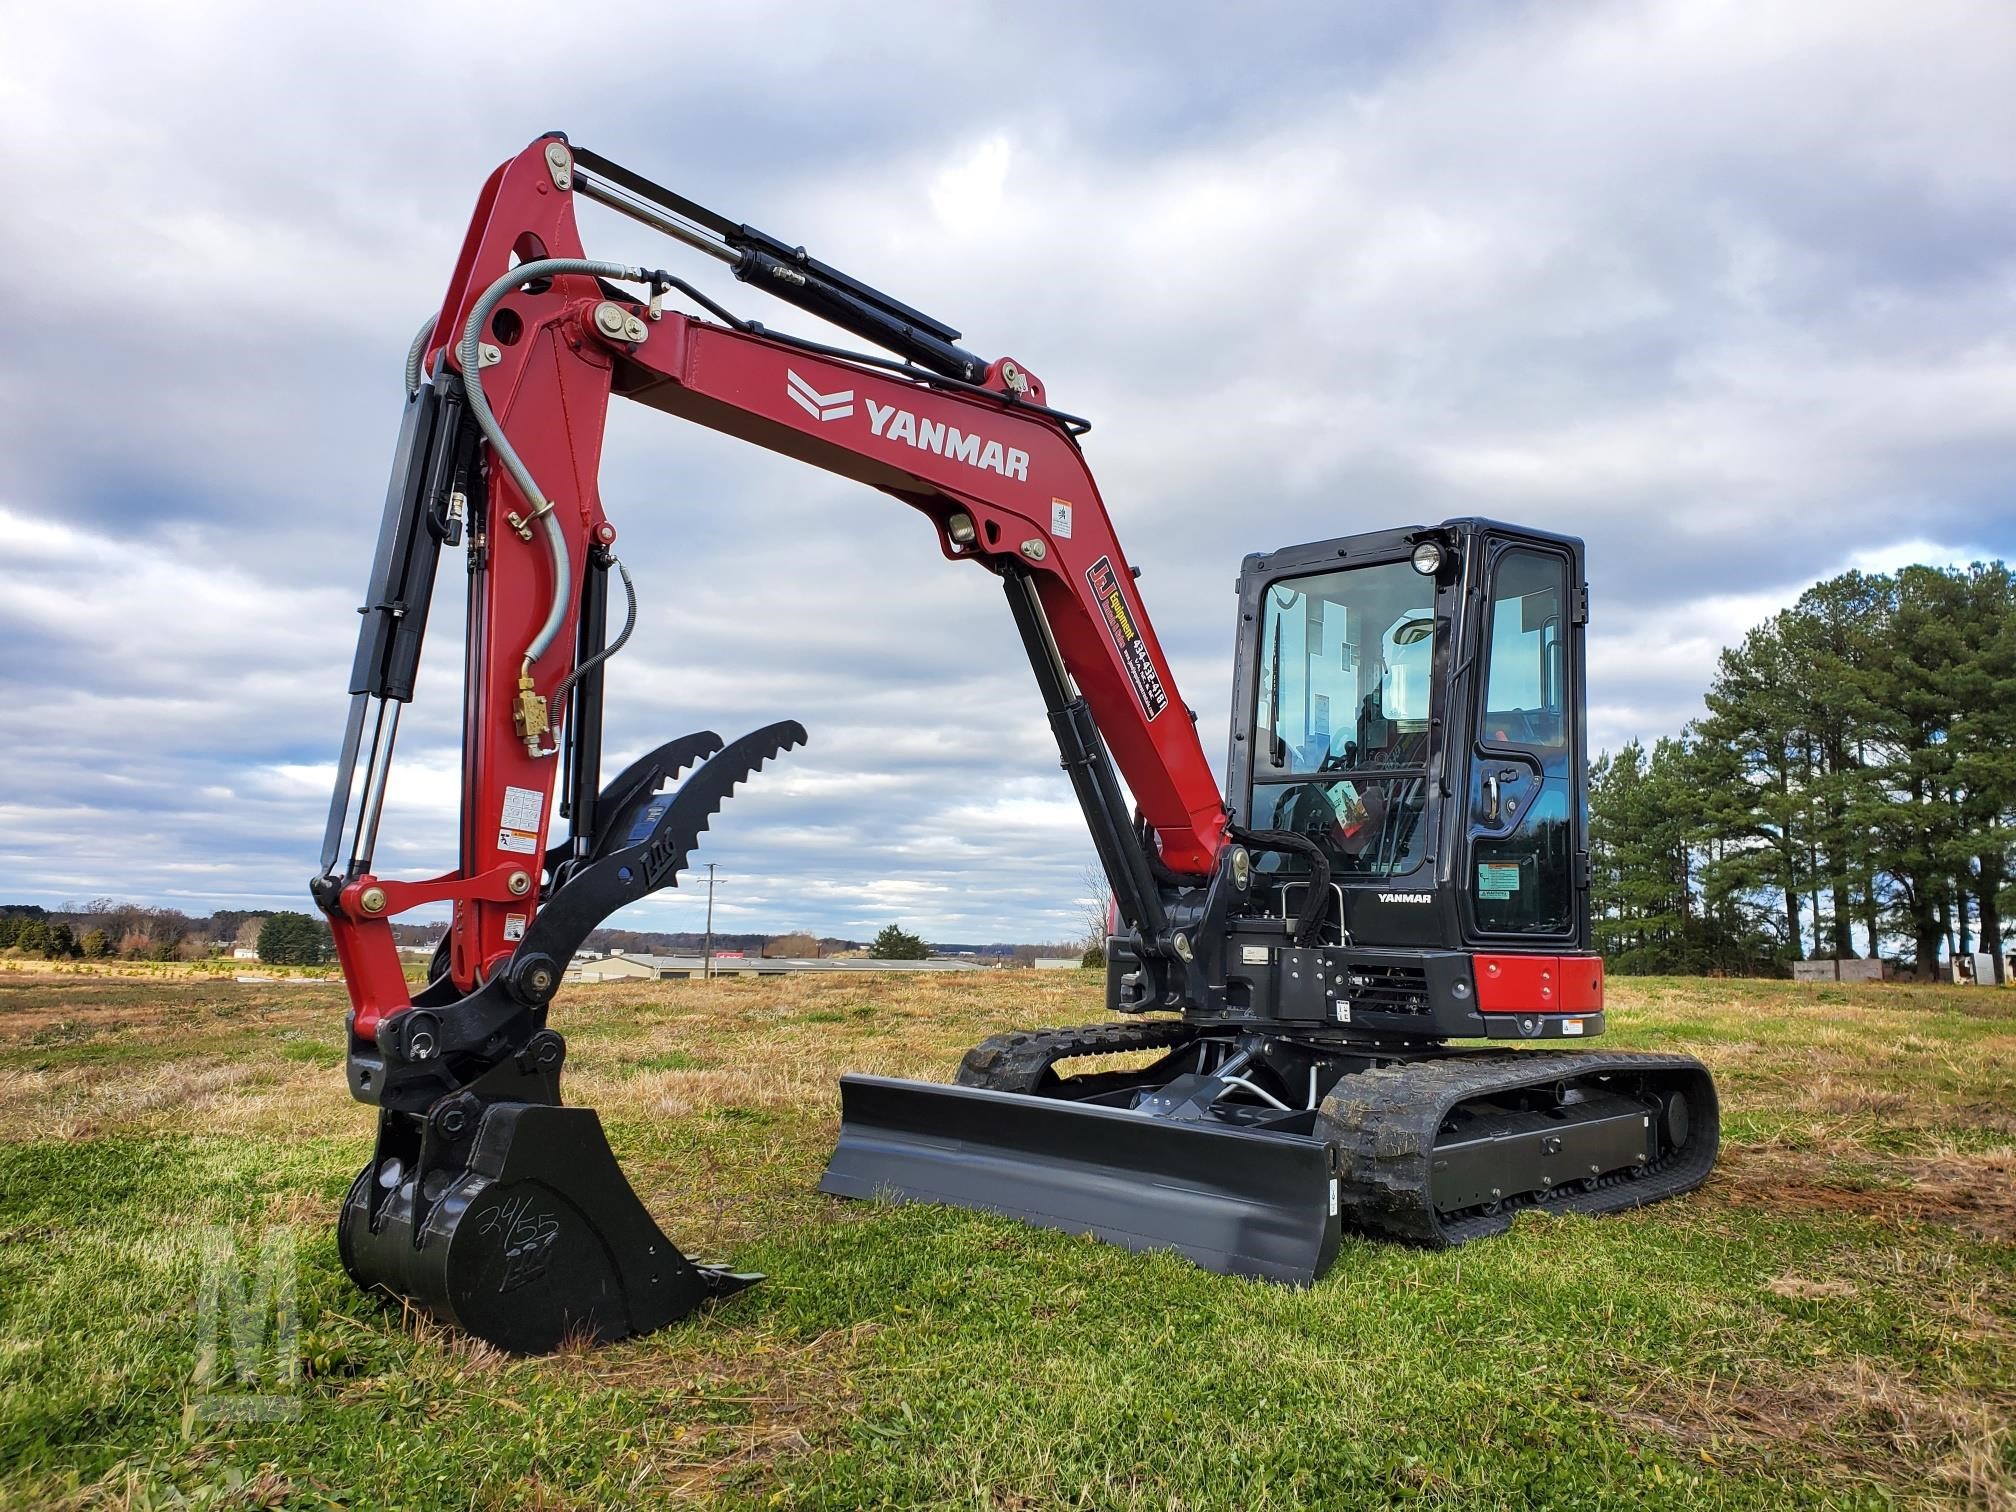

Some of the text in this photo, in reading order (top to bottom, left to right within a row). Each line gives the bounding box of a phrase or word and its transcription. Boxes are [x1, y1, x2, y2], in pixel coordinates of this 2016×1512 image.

[865, 398, 1029, 482] YANMAR
[1109, 591, 1134, 641] Equipment
[1133, 639, 1166, 709] 434-432-4181
[1378, 894, 1431, 903] YANMAR
[475, 1195, 559, 1251] 24/55
